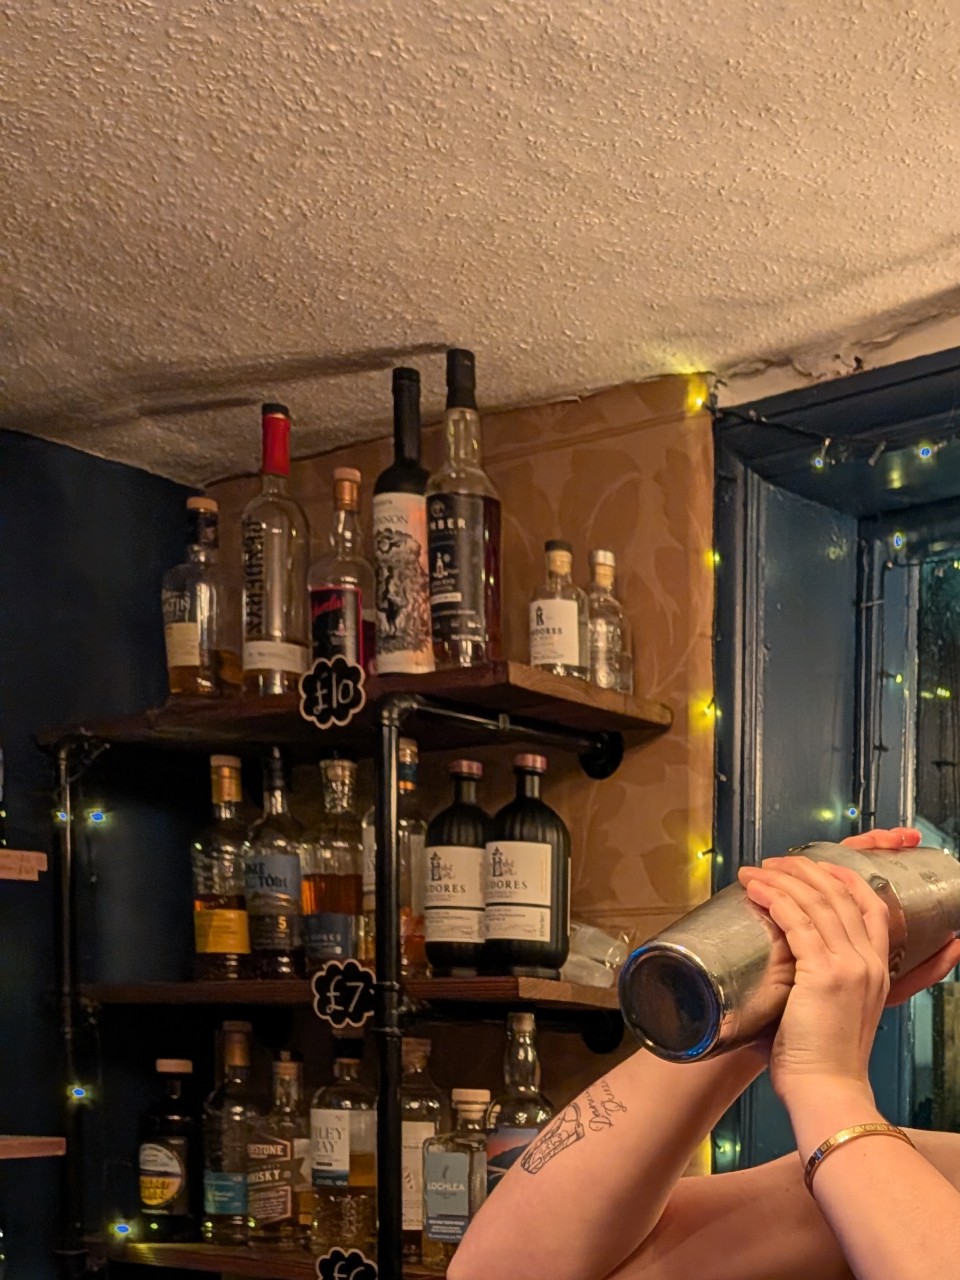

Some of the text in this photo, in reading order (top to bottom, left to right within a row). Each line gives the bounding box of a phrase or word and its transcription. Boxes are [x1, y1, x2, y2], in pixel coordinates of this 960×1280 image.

[313, 671, 355, 716] £10
[325, 974, 365, 1014] £7
[427, 1182, 466, 1192] LOCHLEA
